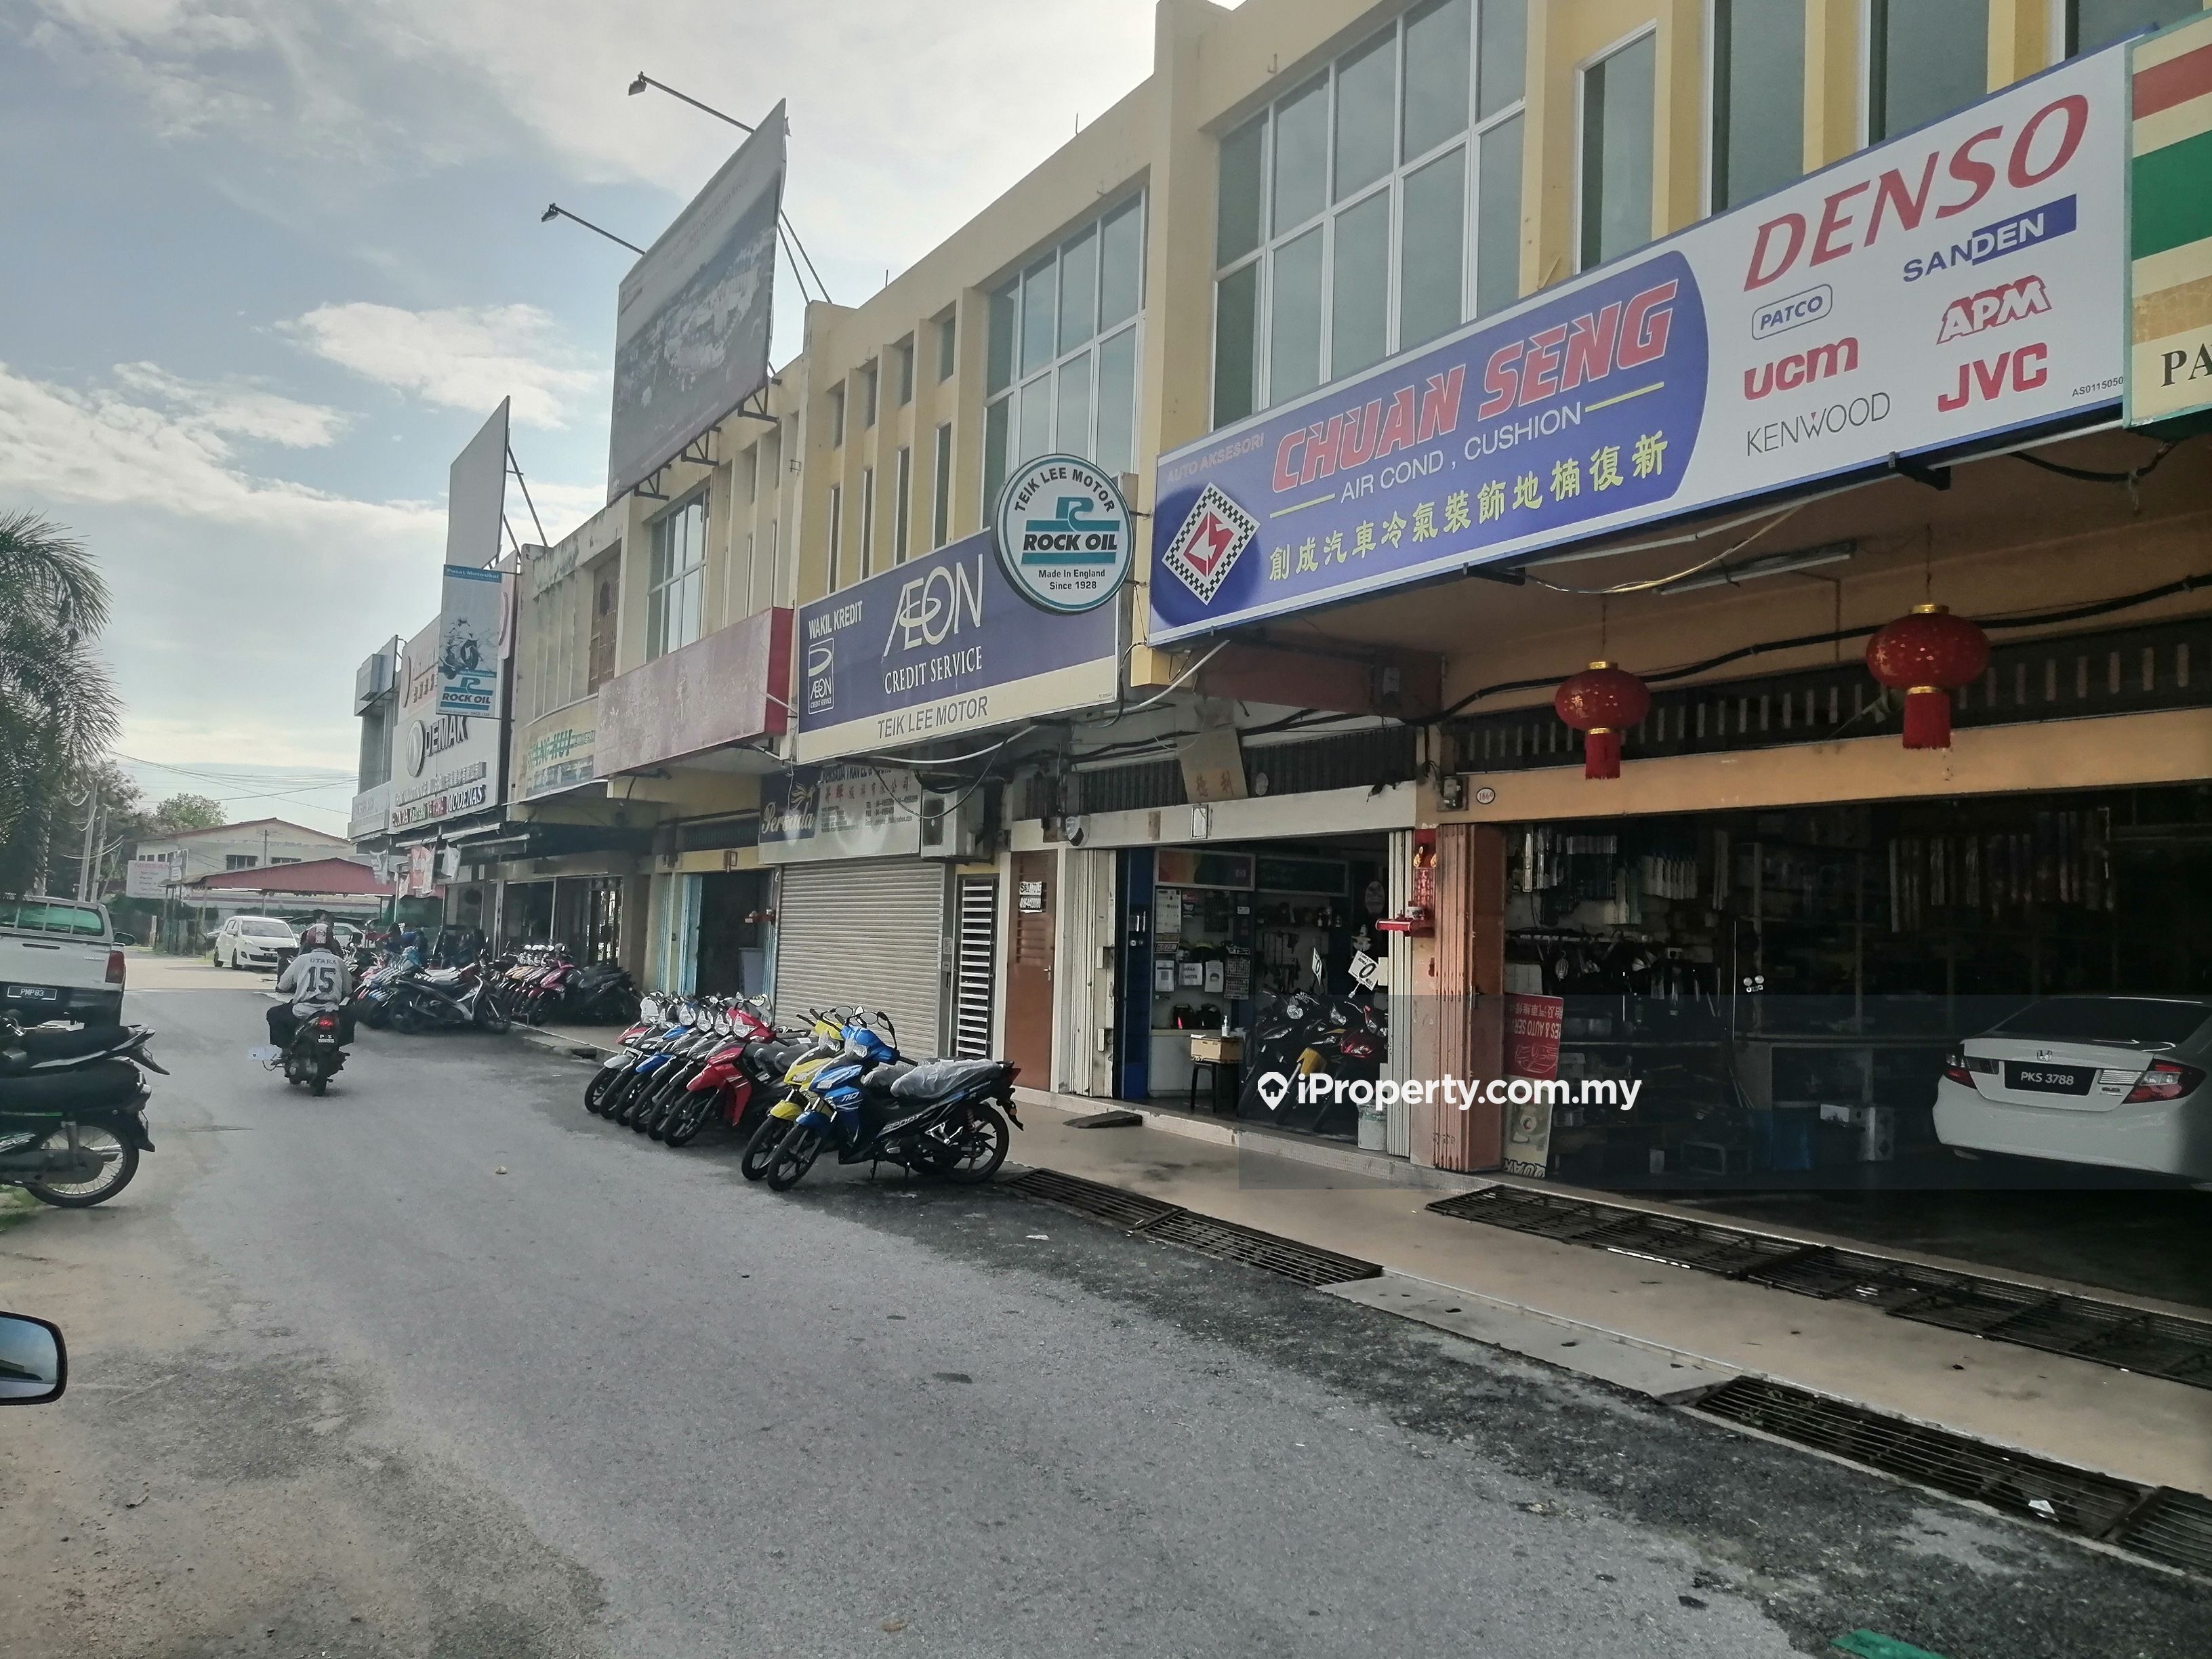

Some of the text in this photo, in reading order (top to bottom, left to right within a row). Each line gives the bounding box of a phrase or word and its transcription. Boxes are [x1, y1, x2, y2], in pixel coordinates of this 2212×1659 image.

[1744, 94, 2089, 292] DENSO
[1903, 212, 2044, 283] SANDEN
[1760, 295, 1823, 331] PATCO
[1936, 274, 2052, 345] APM
[1272, 279, 1679, 493] CHUAN SENG
[1744, 337, 1858, 401] ucm
[1938, 342, 2048, 412] JVC
[2160, 343, 2212, 388] PA
[1747, 392, 1891, 456] KENWOOD
[1167, 432, 1265, 484] AUTO AKSESORI
[1340, 474, 1374, 504] AIR
[1465, 401, 1581, 460] CUSHION
[1015, 467, 1115, 512] TEIK LEE MOTOR
[1023, 533, 1118, 551] ROCK OIL
[1039, 569, 1105, 579] Made In England
[1050, 581, 1097, 590] Since 1928
[808, 600, 863, 640] WAKIL KREDIT
[884, 645, 983, 695] CREDIT SERVICE
[442, 693, 491, 704] ROCK OIL
[878, 695, 988, 739] TEIK LEE MOTOR
[424, 716, 469, 758] DEMAK
[447, 784, 487, 813] MODENAS
[306, 966, 336, 994] 15
[2021, 1071, 2074, 1086] PKS 3788
